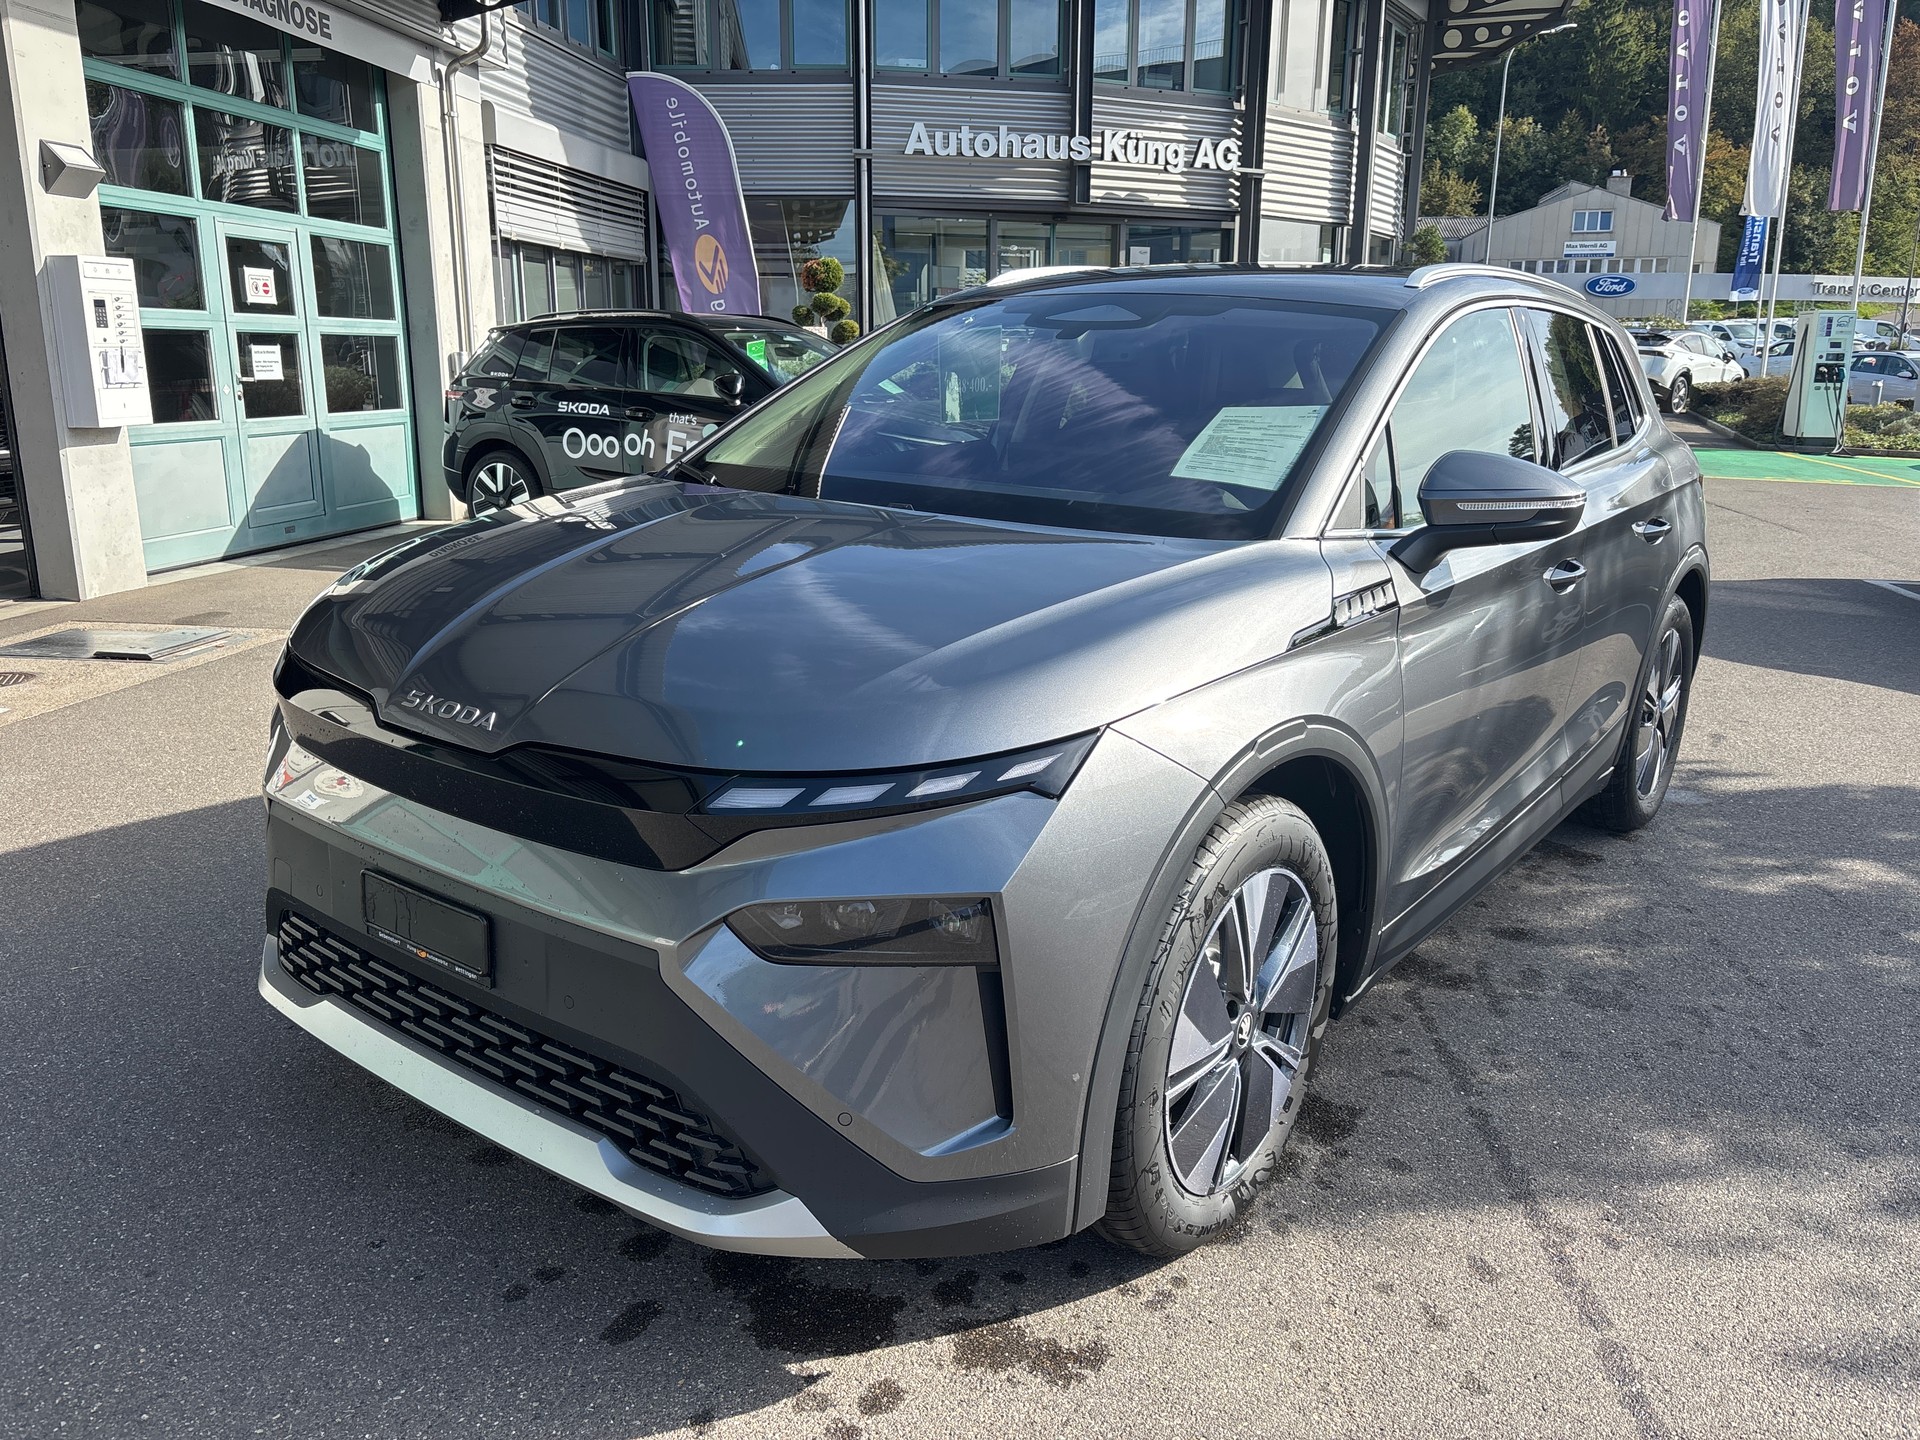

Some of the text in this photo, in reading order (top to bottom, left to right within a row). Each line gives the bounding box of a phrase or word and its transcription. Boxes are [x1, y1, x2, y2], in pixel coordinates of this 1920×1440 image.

[229, 0, 332, 40] AGNOSE
[904, 122, 1241, 174] Autohaus Küng AG
[1595, 278, 1628, 292] Ford
[1813, 282, 1865, 296] Transt
[669, 411, 698, 426] that's
